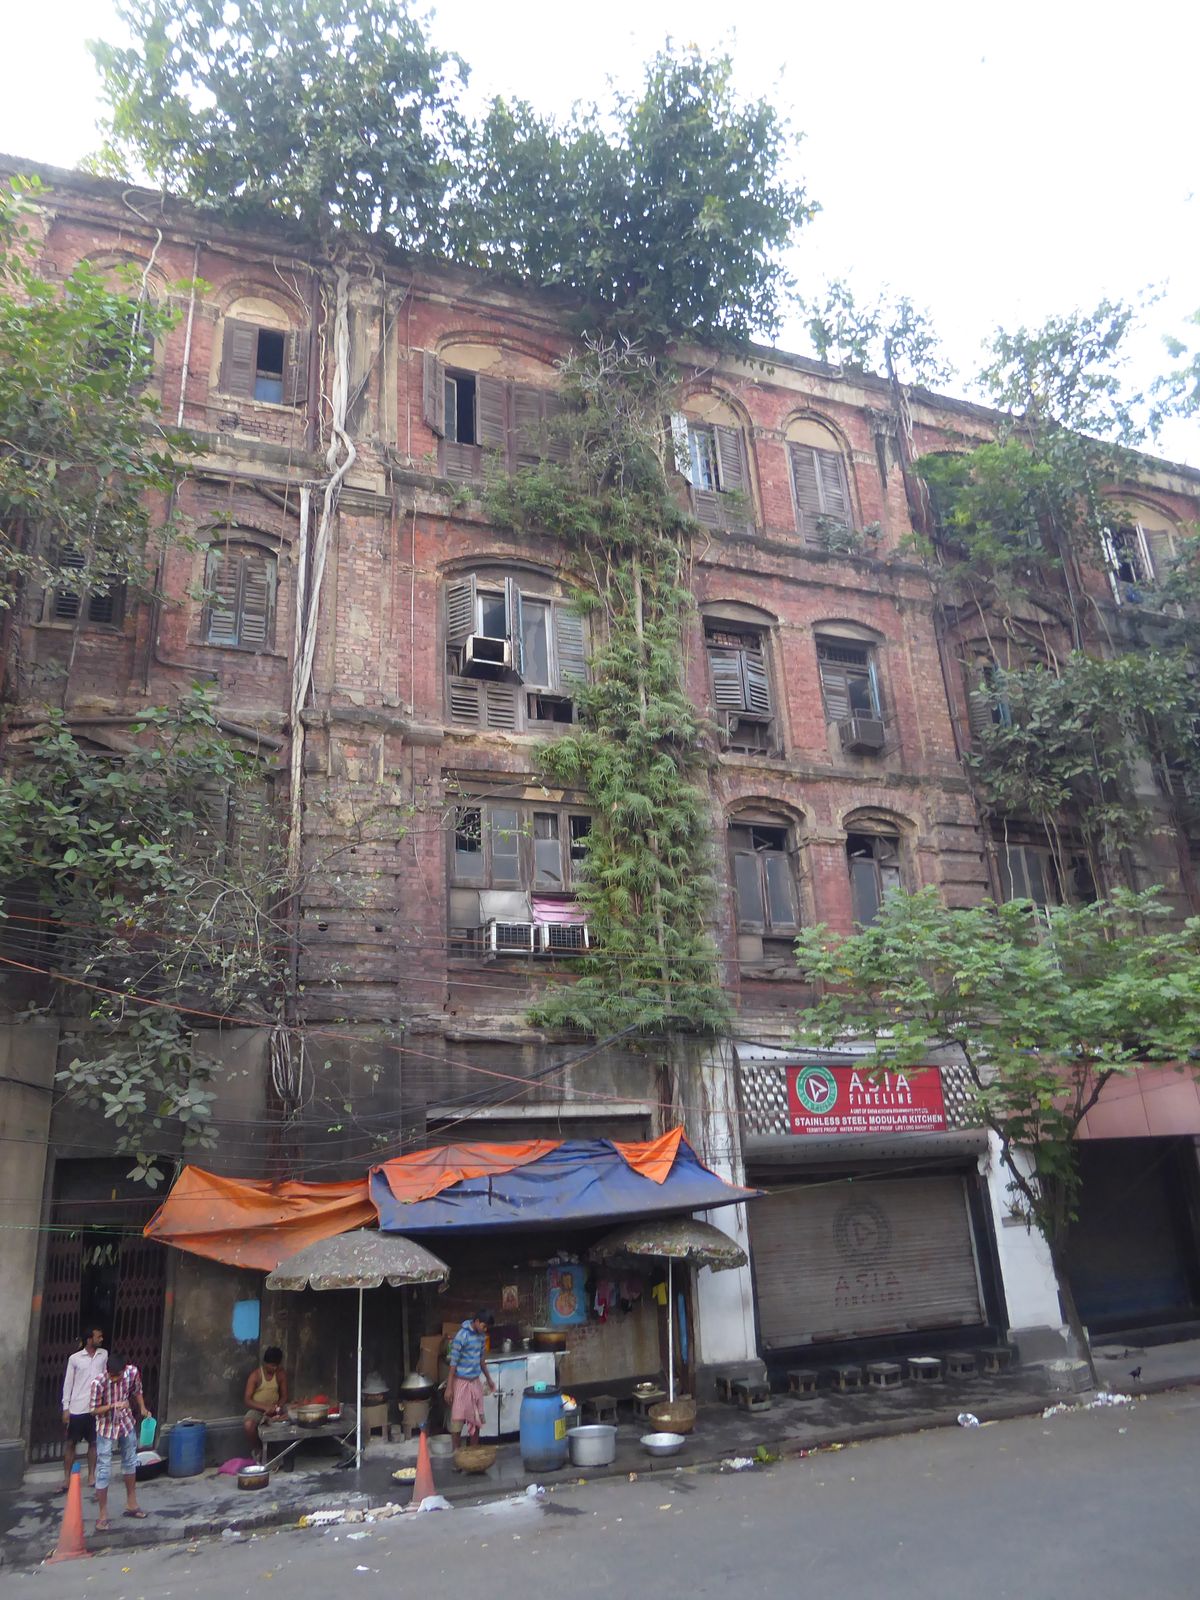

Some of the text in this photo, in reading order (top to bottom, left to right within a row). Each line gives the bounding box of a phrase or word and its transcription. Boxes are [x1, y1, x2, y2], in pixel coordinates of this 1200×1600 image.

[848, 1092, 913, 1105] FINELINE
[794, 1113, 943, 1127] STAINLESS STEEL MODULAR KITCHEN
